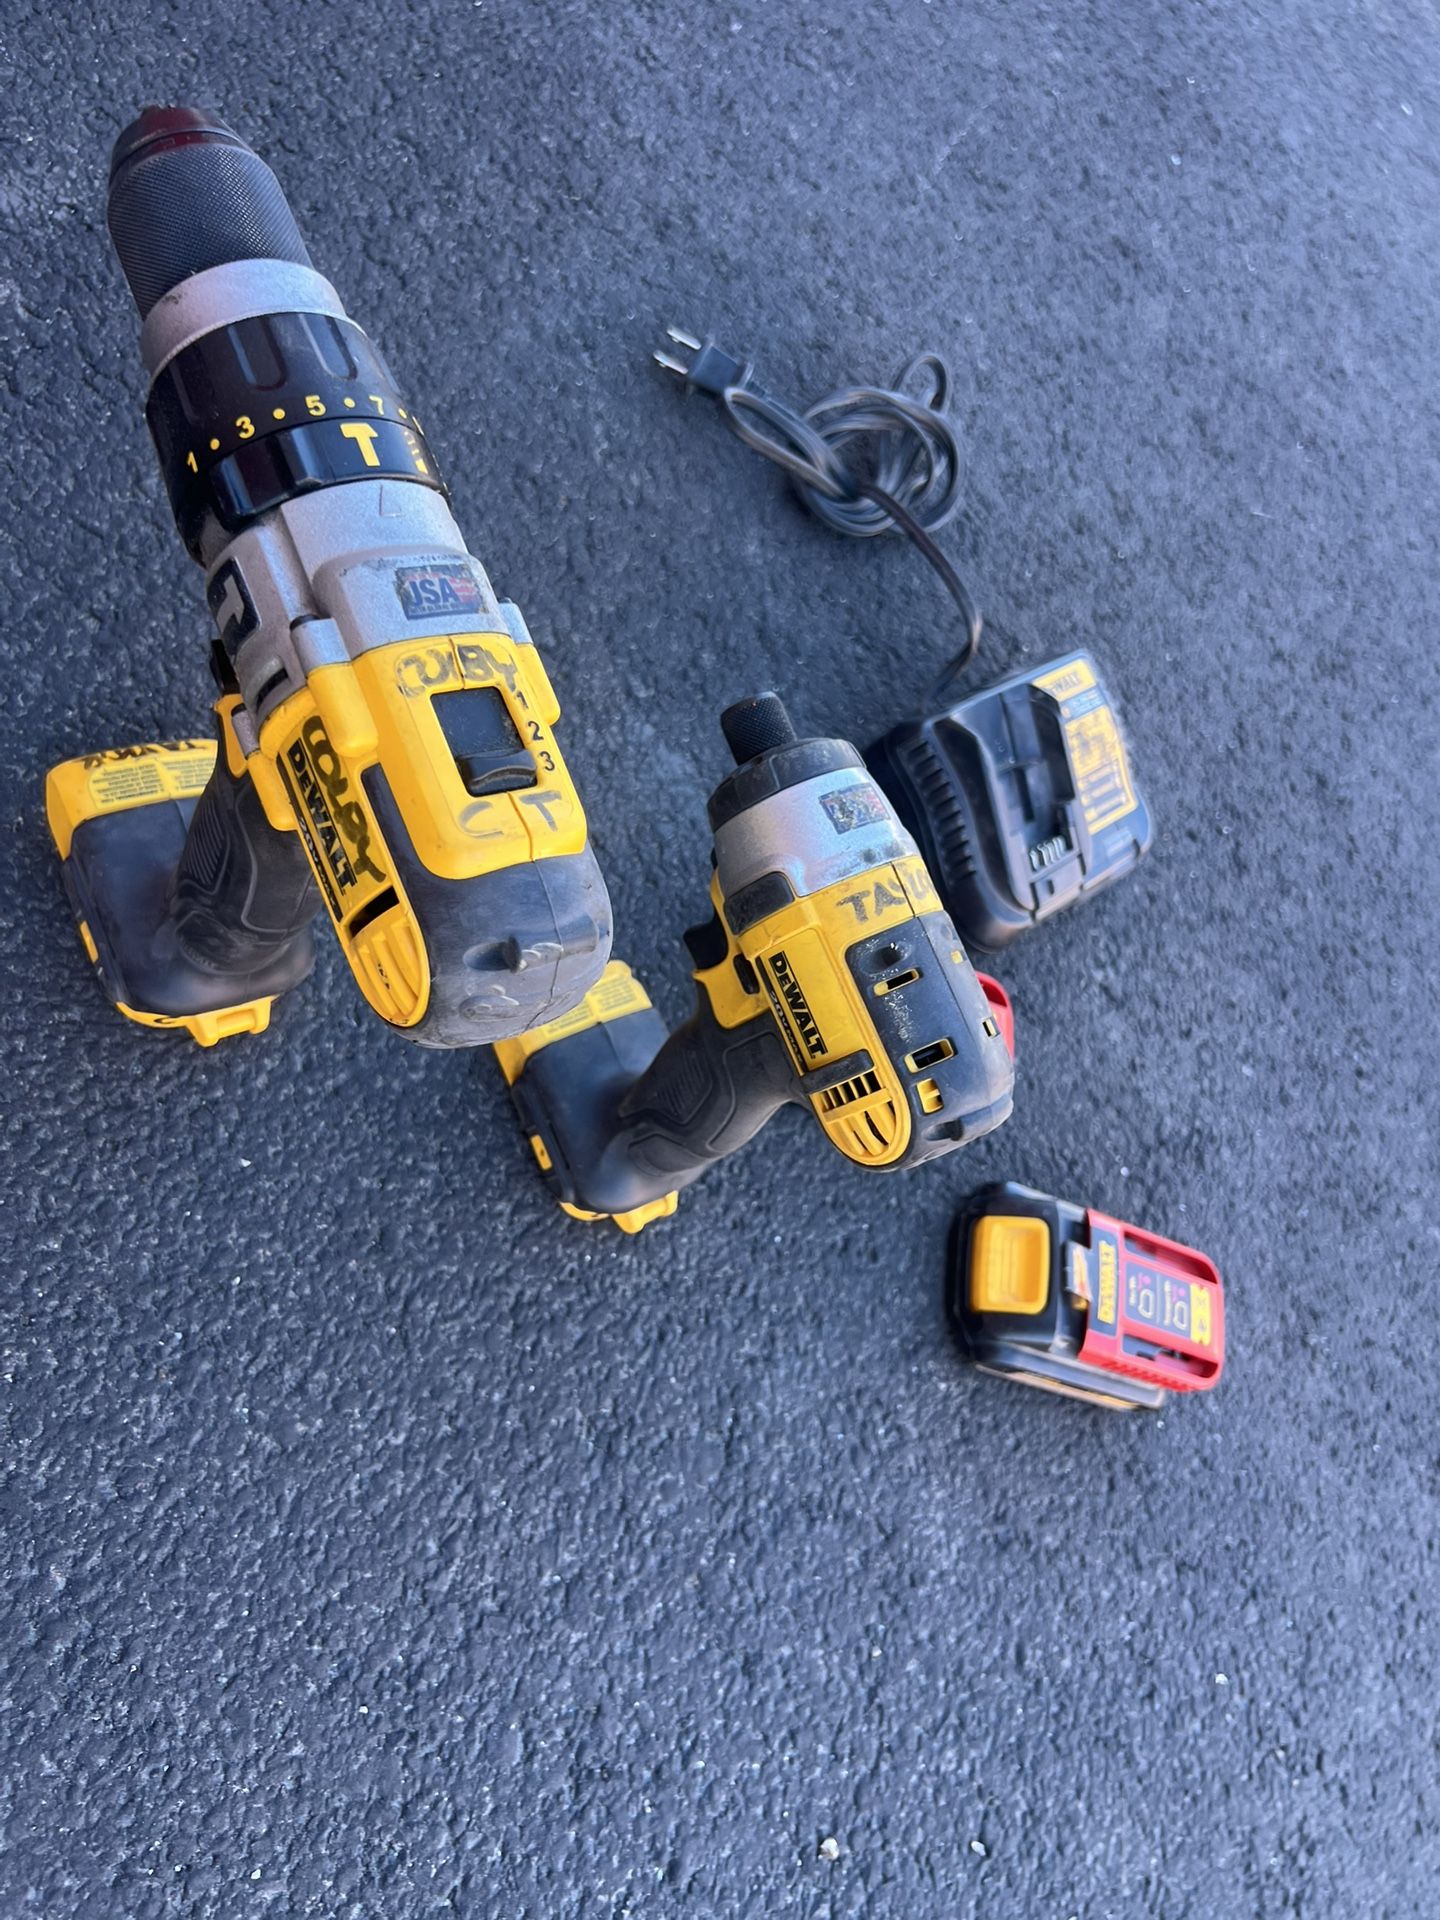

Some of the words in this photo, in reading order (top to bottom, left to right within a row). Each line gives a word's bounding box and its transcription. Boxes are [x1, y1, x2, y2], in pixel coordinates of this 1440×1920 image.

[186, 451, 198, 474] 1
[235, 415, 256, 439] 3
[305, 395, 327, 417] 5
[368, 395, 385, 416] 7
[516, 691, 529, 710] 1
[527, 720, 545, 741] 2
[539, 750, 556, 772] 3
